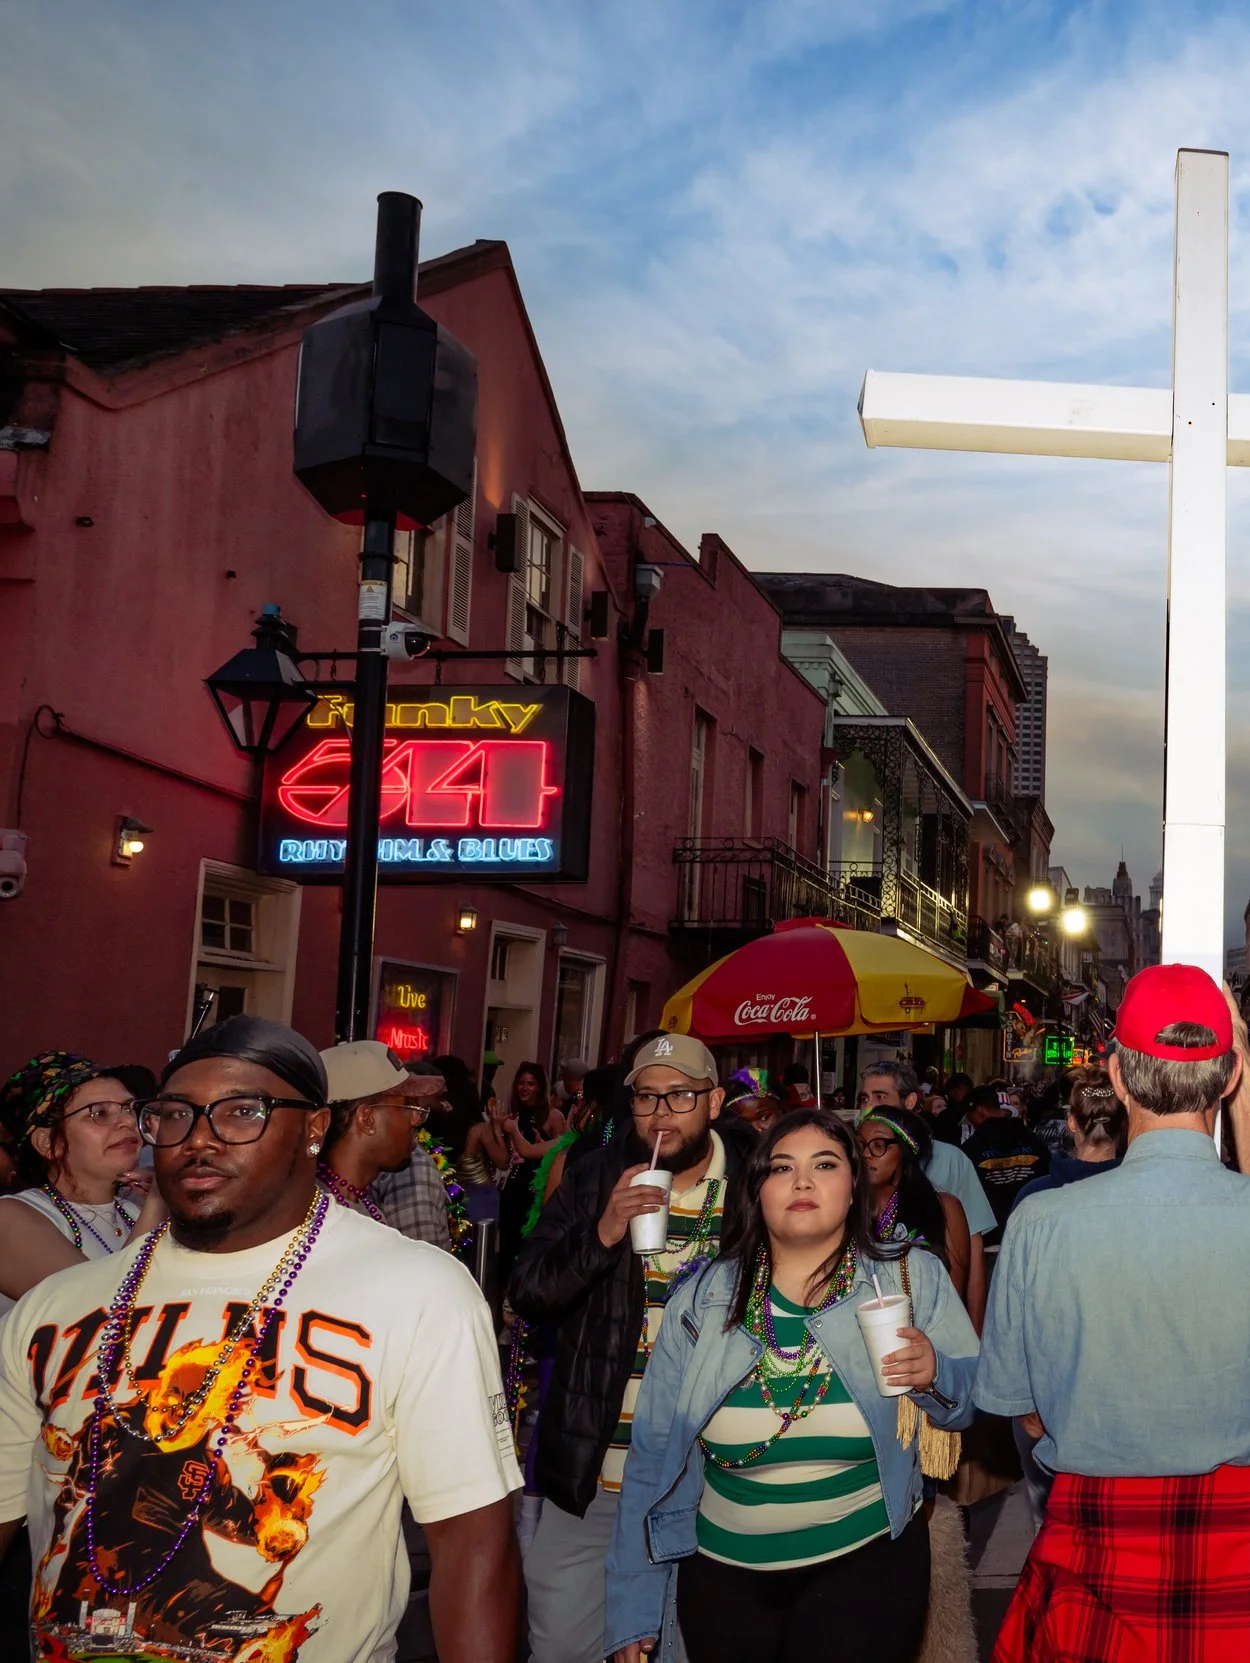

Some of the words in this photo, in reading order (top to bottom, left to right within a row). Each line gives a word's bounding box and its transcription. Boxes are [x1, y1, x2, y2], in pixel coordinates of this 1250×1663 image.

[279, 838, 421, 862] RHYHM
[425, 839, 453, 862] &
[458, 838, 554, 862] BLUES
[398, 984, 426, 1008] Live
[756, 993, 776, 1001] Enjoy
[389, 1027, 429, 1050] Music
[654, 1037, 674, 1057] LA
